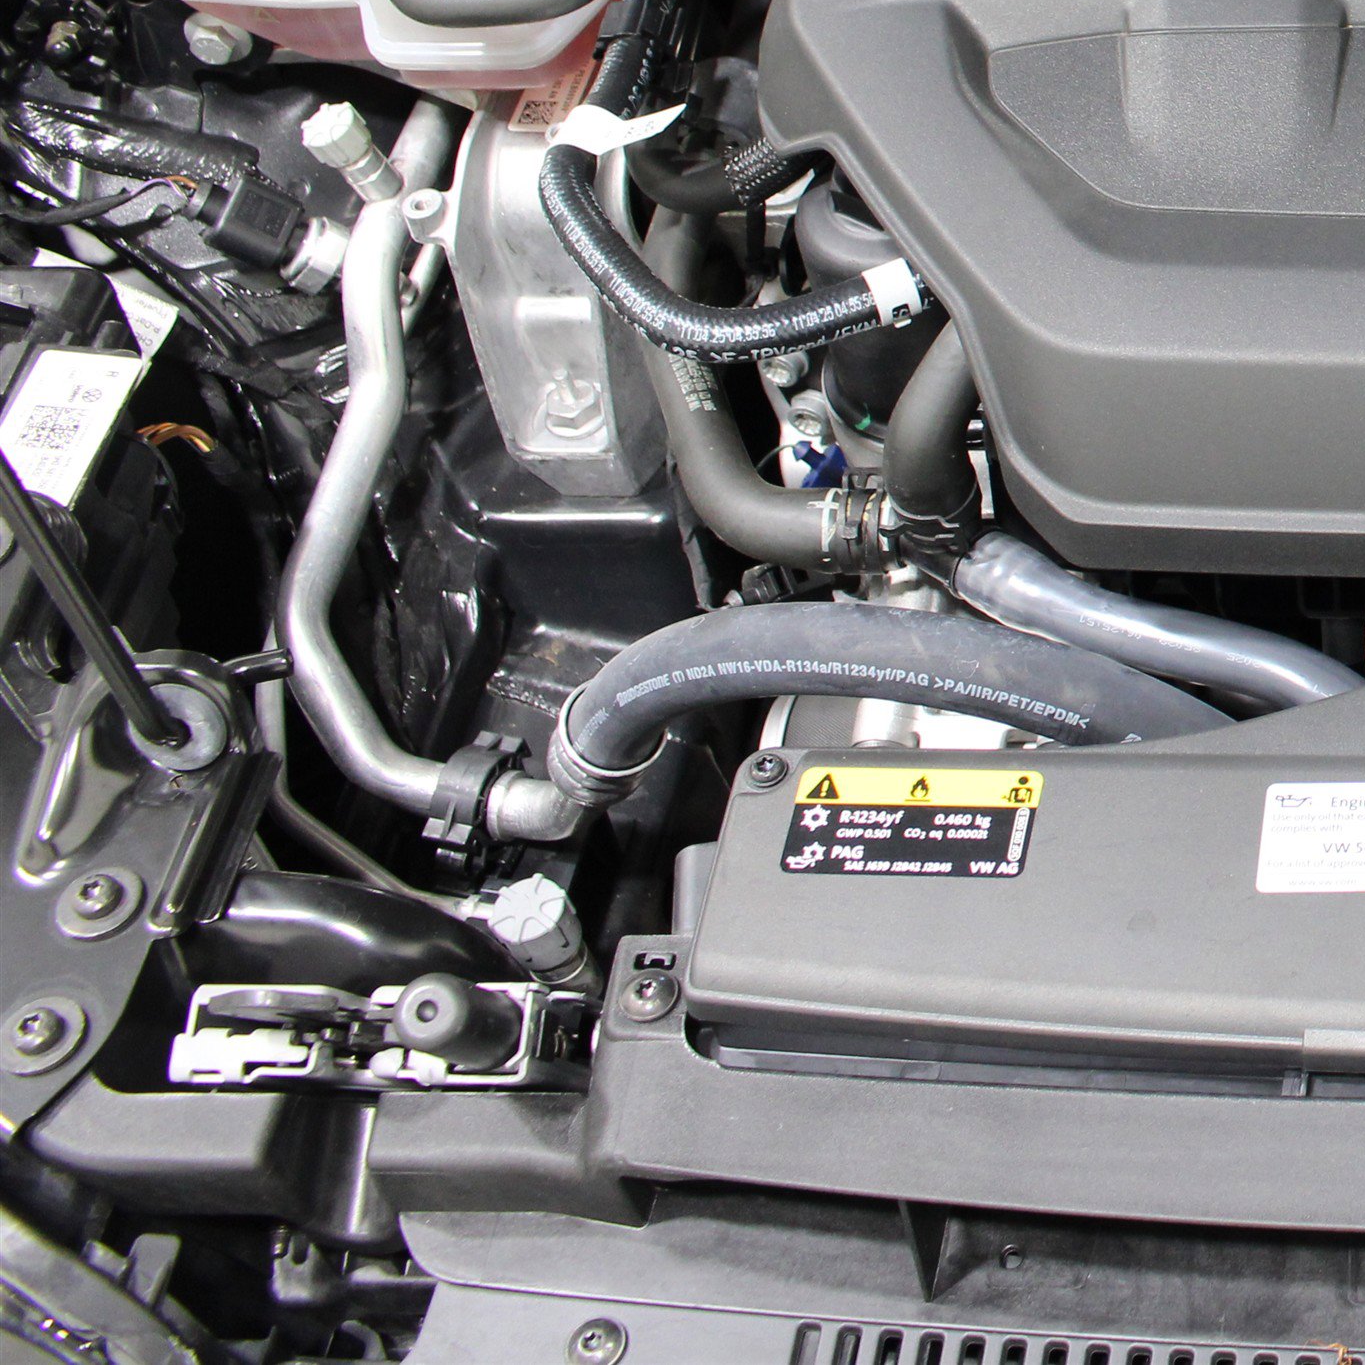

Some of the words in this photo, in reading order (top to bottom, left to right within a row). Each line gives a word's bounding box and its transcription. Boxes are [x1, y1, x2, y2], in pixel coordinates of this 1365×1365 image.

[686, 663, 716, 683] ND2A
[840, 810, 904, 827] R-1234yf
[935, 814, 971, 825] 0.460
[976, 815, 991, 828] kg
[1294, 814, 1316, 822] only
[836, 829, 863, 839] GWP
[864, 829, 891, 839] 0.501
[929, 831, 943, 840] eq
[1271, 825, 1316, 833] complies
[831, 846, 864, 859] PAG
[1323, 843, 1350, 853] VW
[843, 861, 864, 871] SAE
[969, 862, 995, 873] VW
[996, 862, 1019, 874] AG
